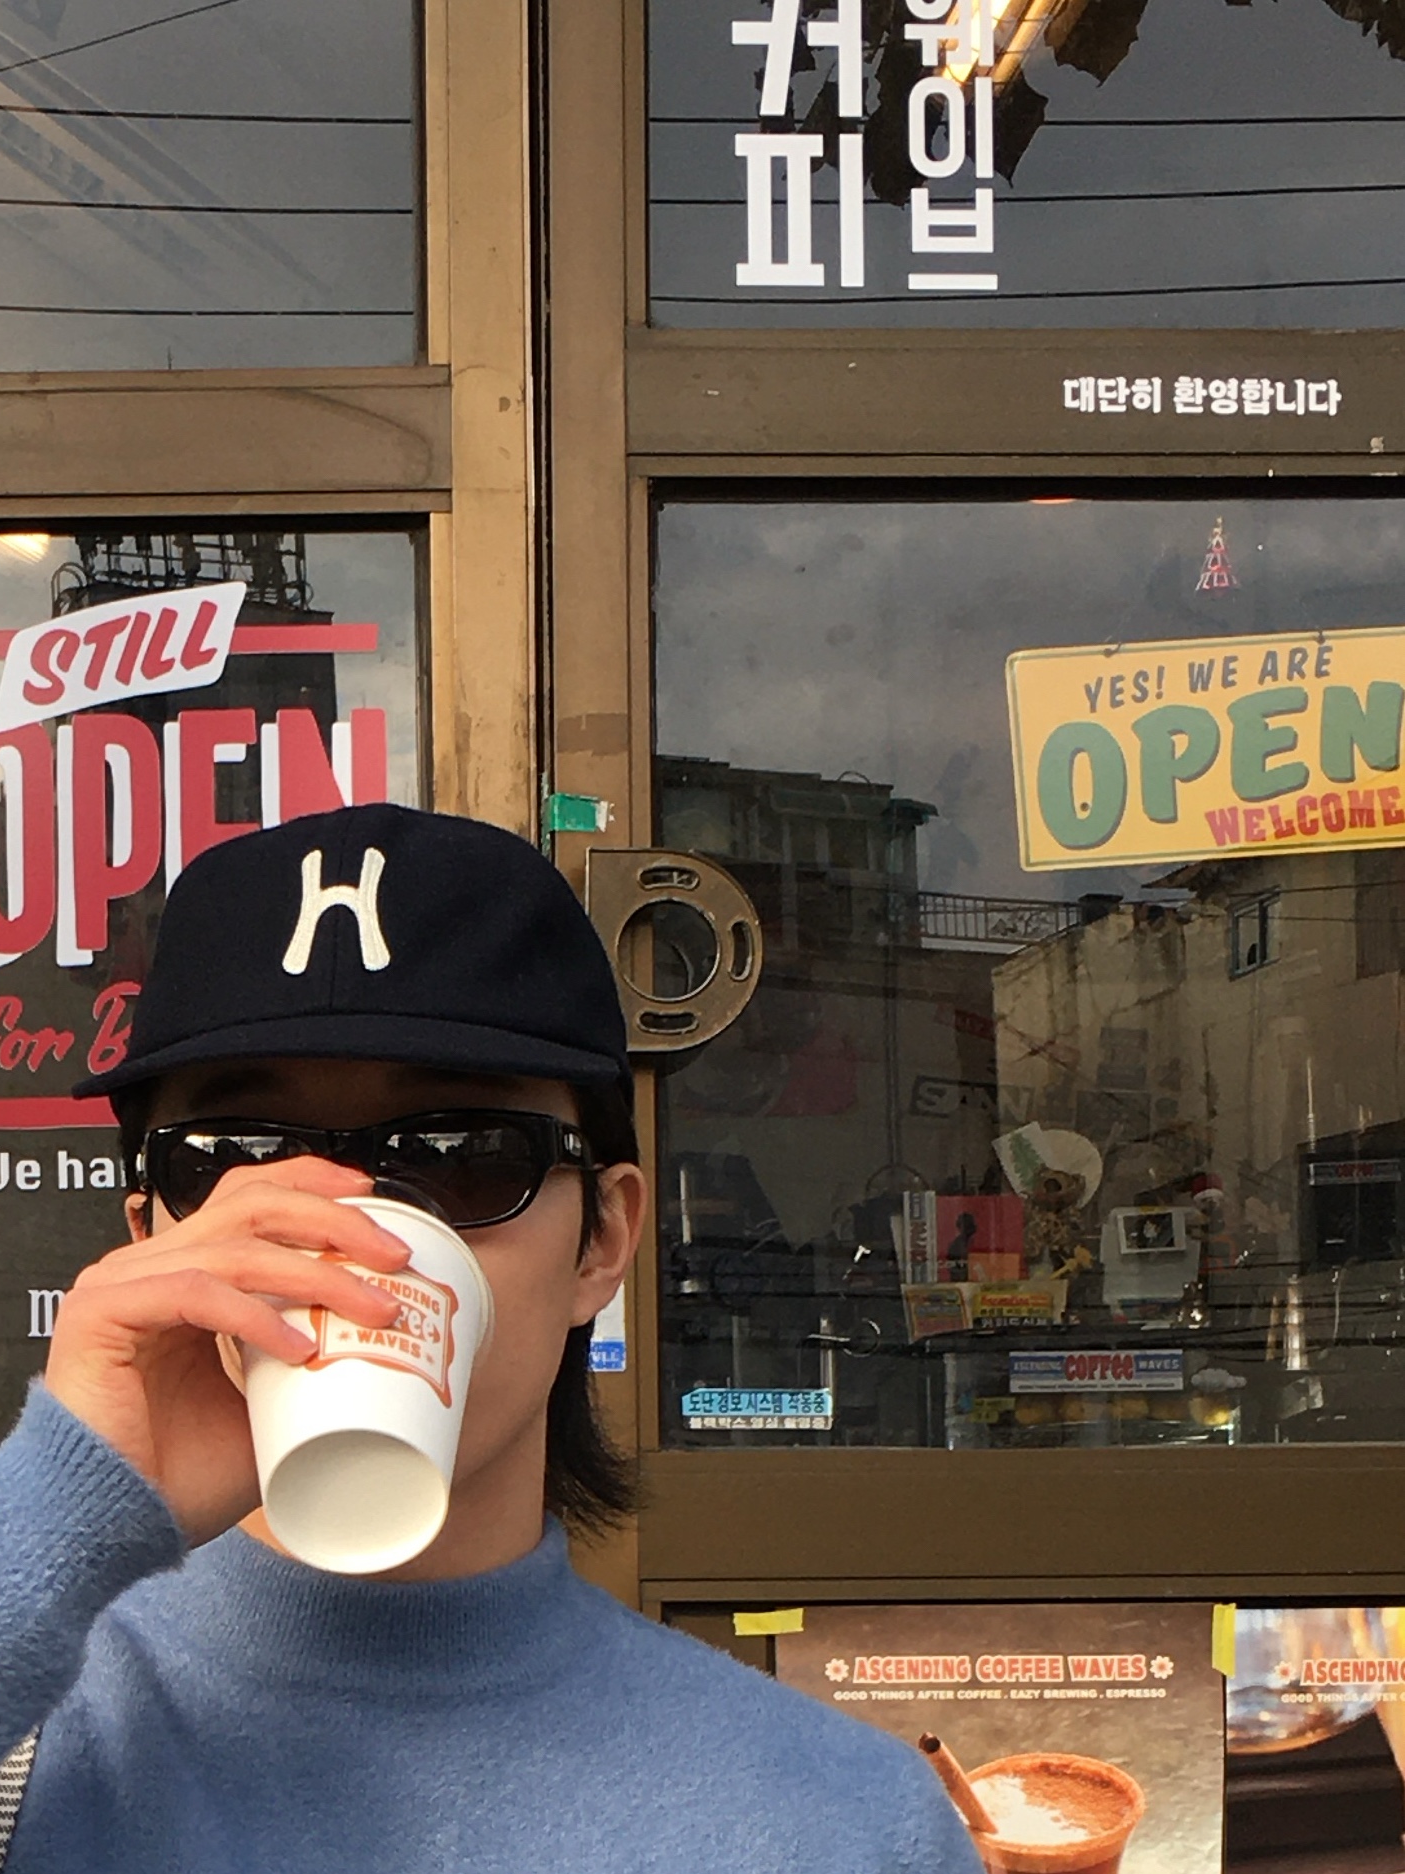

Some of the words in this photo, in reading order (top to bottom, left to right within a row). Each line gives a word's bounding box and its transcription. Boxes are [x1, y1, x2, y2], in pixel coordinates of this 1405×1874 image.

[1063, 376, 1162, 414] 대단히
[1173, 376, 1343, 416] 환영합니다
[22, 600, 218, 706] STILL
[1084, 665, 1166, 713] YES!
[1188, 655, 1239, 694] WE
[1257, 645, 1333, 686] ARE
[1037, 680, 1405, 851] OPEN
[1204, 785, 1405, 848] WELCOME
[282, 846, 391, 975] H
[356, 1329, 422, 1359] WAVES
[833, 1690, 868, 1701] GOOD
[869, 1690, 915, 1700] THINGS
[917, 1690, 955, 1700] AFTER
[956, 1689, 1003, 1700] COFFEE
[1010, 1689, 1041, 1699] EAZY
[1043, 1689, 1098, 1699] BREWING
[1105, 1688, 1168, 1698] ESPRESSO
[853, 1656, 971, 1684] ASCENDING
[975, 1655, 1065, 1683] COFFEE
[1067, 1654, 1147, 1682] WAVES
